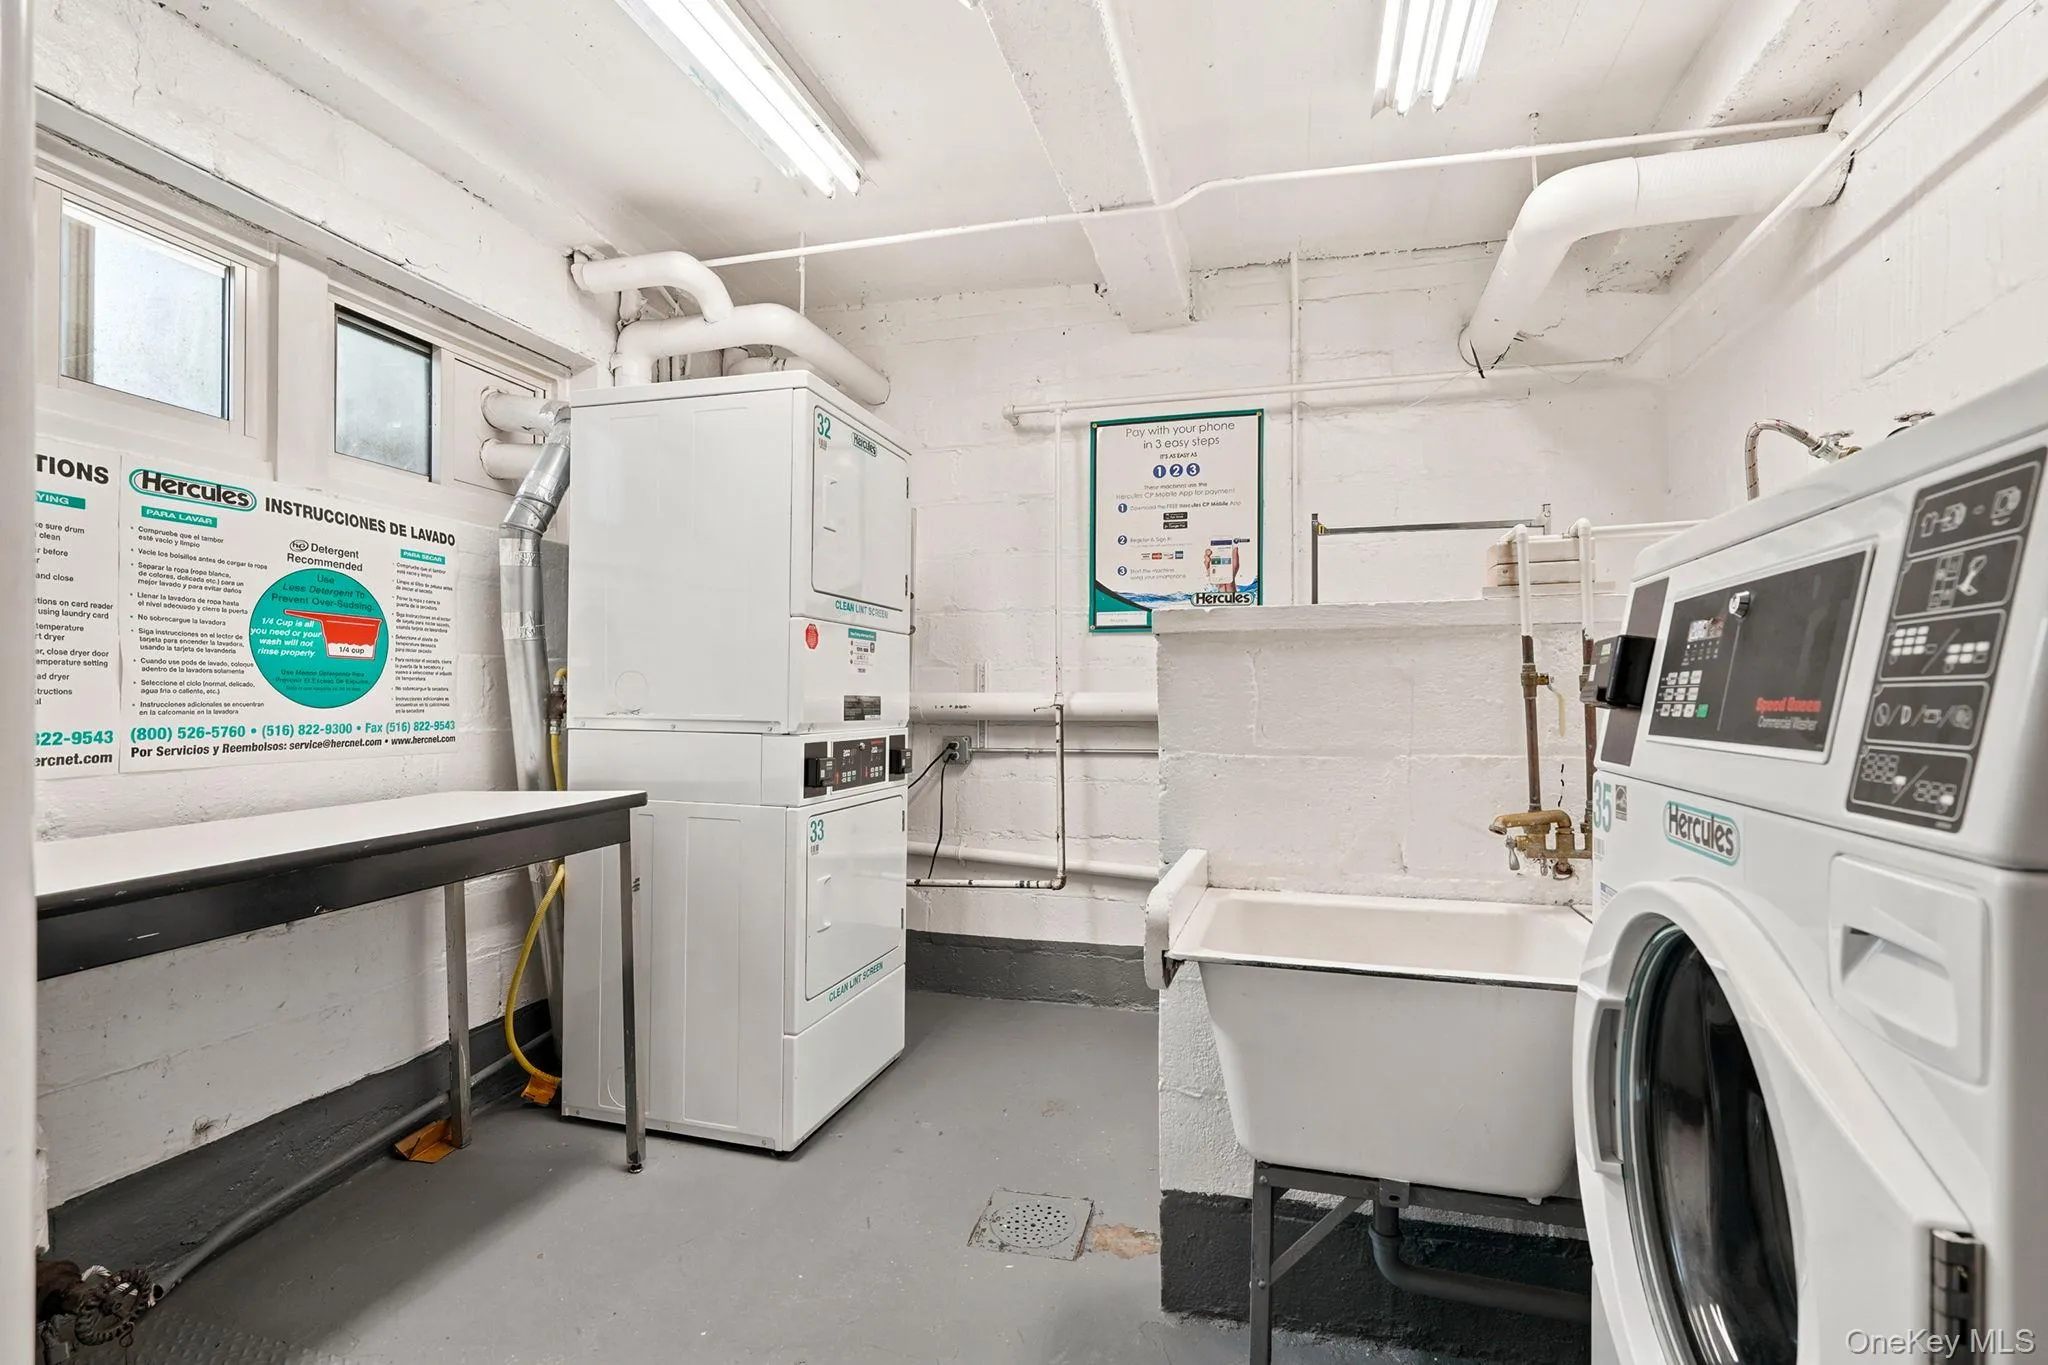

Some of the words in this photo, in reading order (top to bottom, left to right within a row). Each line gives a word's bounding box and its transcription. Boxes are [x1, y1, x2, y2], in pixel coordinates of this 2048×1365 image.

[817, 413, 831, 439] 32
[1126, 428, 1145, 438] Pay
[1148, 425, 1170, 435] with
[1173, 425, 1195, 436] your
[1199, 421, 1235, 435] phone
[854, 433, 876, 454] Hercules
[1143, 440, 1152, 449] in
[1155, 439, 1162, 448] 3
[1165, 439, 1188, 449] easy
[1192, 437, 1219, 448] steps
[142, 470, 249, 507] Hercules
[1205, 488, 1235, 496] payment
[147, 509, 176, 519] PARA
[180, 513, 212, 524] LAVAR
[266, 497, 386, 533] INSTRUCCIONES
[390, 522, 407, 536] DE
[411, 527, 455, 546] LAVADO
[45, 523, 62, 531] sure
[65, 525, 84, 534] drum
[138, 526, 178, 538] Compruebe
[201, 535, 224, 543] tambor
[39, 532, 60, 541] clean
[180, 540, 200, 548] limpio
[43, 548, 68, 556] before
[311, 543, 359, 558] Detergent
[170, 552, 197, 561] bolsillos
[198, 556, 215, 564] antes
[287, 553, 363, 572] Recommended
[53, 573, 73, 581] close
[317, 574, 334, 583] Use
[272, 593, 308, 603] Prevent
[309, 586, 353, 598] Detergent
[355, 590, 365, 598] To
[71, 600, 88, 608] card
[1196, 593, 1250, 605] Hercules
[38, 608, 59, 617] using
[62, 609, 90, 619] laundry
[835, 600, 854, 613] CLEAN
[856, 604, 868, 615] LINT
[150, 615, 190, 623] sobrecargue
[276, 619, 293, 627] Cup
[36, 623, 84, 631] temperature
[269, 628, 290, 636] need
[303, 630, 321, 638] your
[44, 633, 65, 641] dryer
[281, 649, 315, 658] properly
[83, 660, 108, 668] setting
[49, 673, 69, 681] dryer
[130, 727, 172, 743] (800)
[177, 726, 246, 740] 526-5760
[262, 725, 294, 738] (516)
[298, 724, 352, 736] 822-9300
[365, 723, 382, 733] Fax
[386, 722, 411, 734] (516)
[413, 721, 455, 731] 822-9543
[131, 747, 152, 758] Por
[156, 744, 209, 756] Servicios
[212, 746, 219, 757] y
[222, 741, 287, 754] Reembolsos:
[289, 738, 382, 750] service@hercnet.com
[391, 735, 455, 746] www.hercnet.com
[1594, 779, 1611, 832] 35
[810, 819, 824, 843] 33
[1668, 802, 1734, 856] Hercules
[828, 983, 848, 1002] CLEAN
[849, 974, 862, 990] LINT
[862, 962, 884, 980] SCREEN
